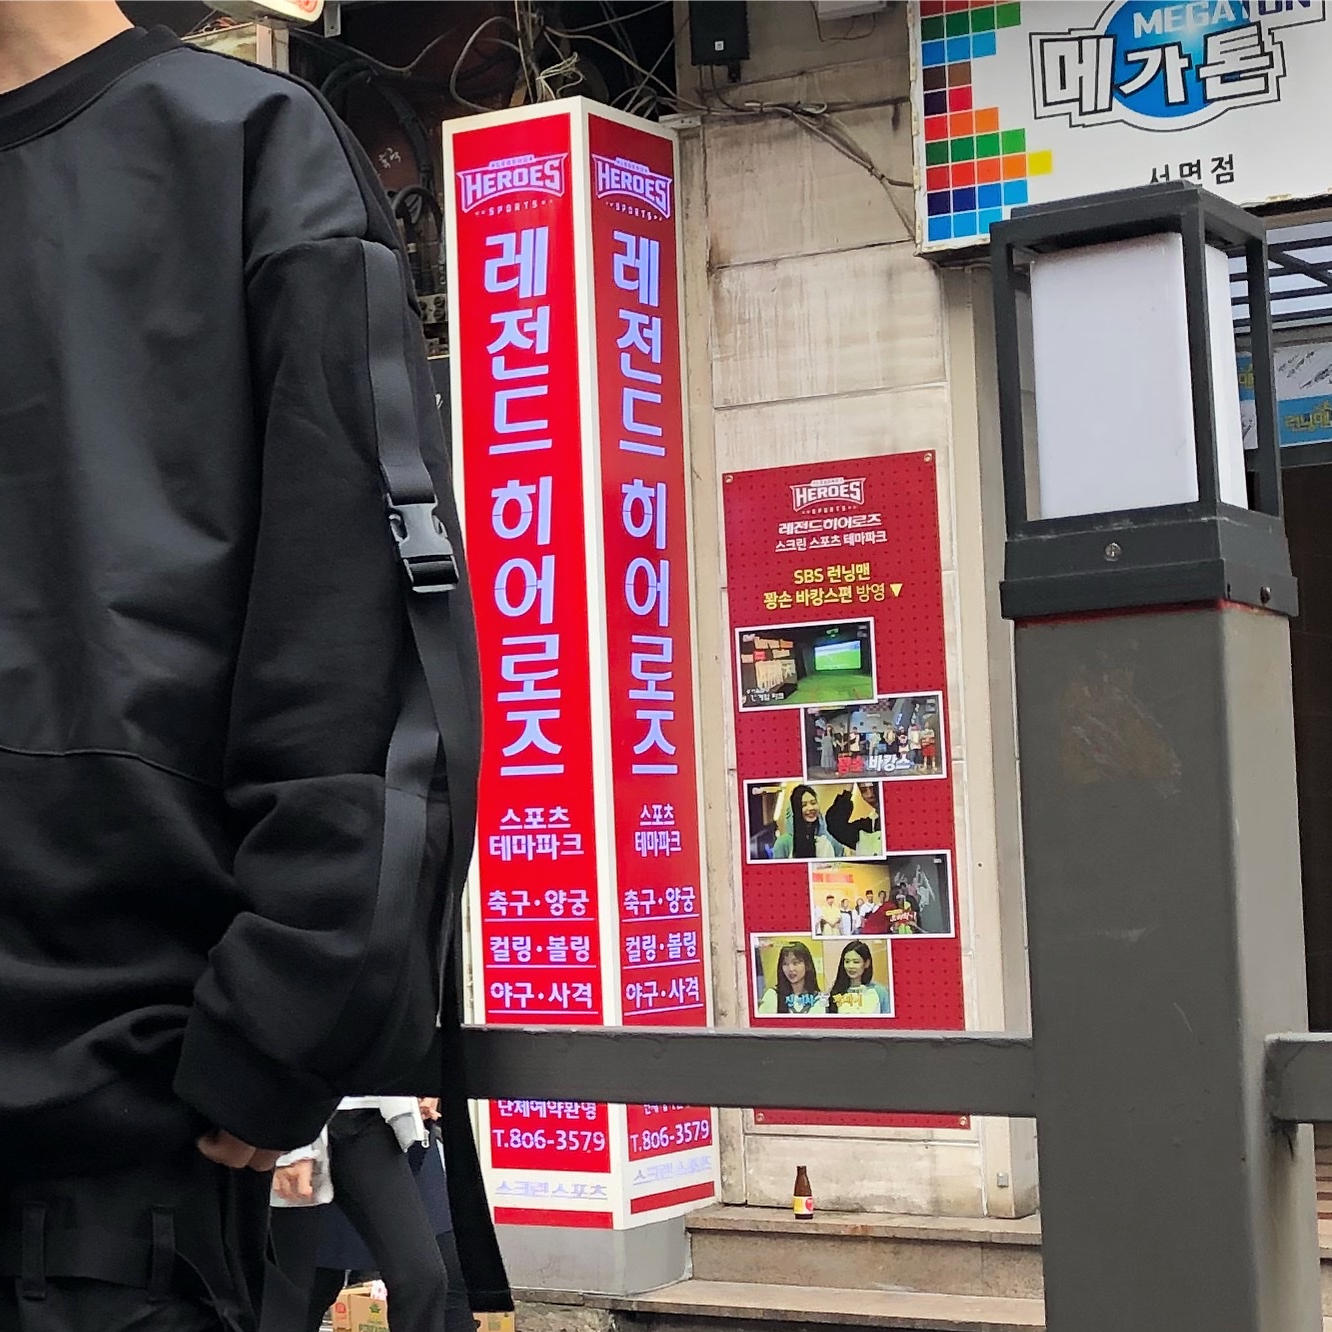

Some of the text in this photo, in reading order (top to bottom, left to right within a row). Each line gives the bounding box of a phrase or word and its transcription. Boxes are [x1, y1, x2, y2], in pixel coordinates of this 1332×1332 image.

[1040, 20, 1274, 116] 메가톤
[466, 158, 561, 204] HEROES
[597, 160, 667, 208] HEROES
[488, 199, 538, 216] SPORTS
[615, 201, 653, 221] SPORTS
[484, 226, 565, 776] 레전드 히어로즈
[613, 230, 678, 775] 레전드 히어로즈
[795, 481, 862, 508] HEROES
[778, 513, 883, 536] 레전드히어로즈
[775, 530, 888, 553] 스크린 스포츠 테마파크
[794, 562, 871, 585] SBS 런닝맨
[856, 582, 886, 603] 방영
[499, 806, 571, 830] 스포츠
[640, 803, 675, 826] 스포츠
[489, 833, 584, 861] 테마파크
[635, 830, 682, 857] 테마파크
[492, 1128, 605, 1152] T.806-3579
[629, 1119, 710, 1153] T.806-3579
